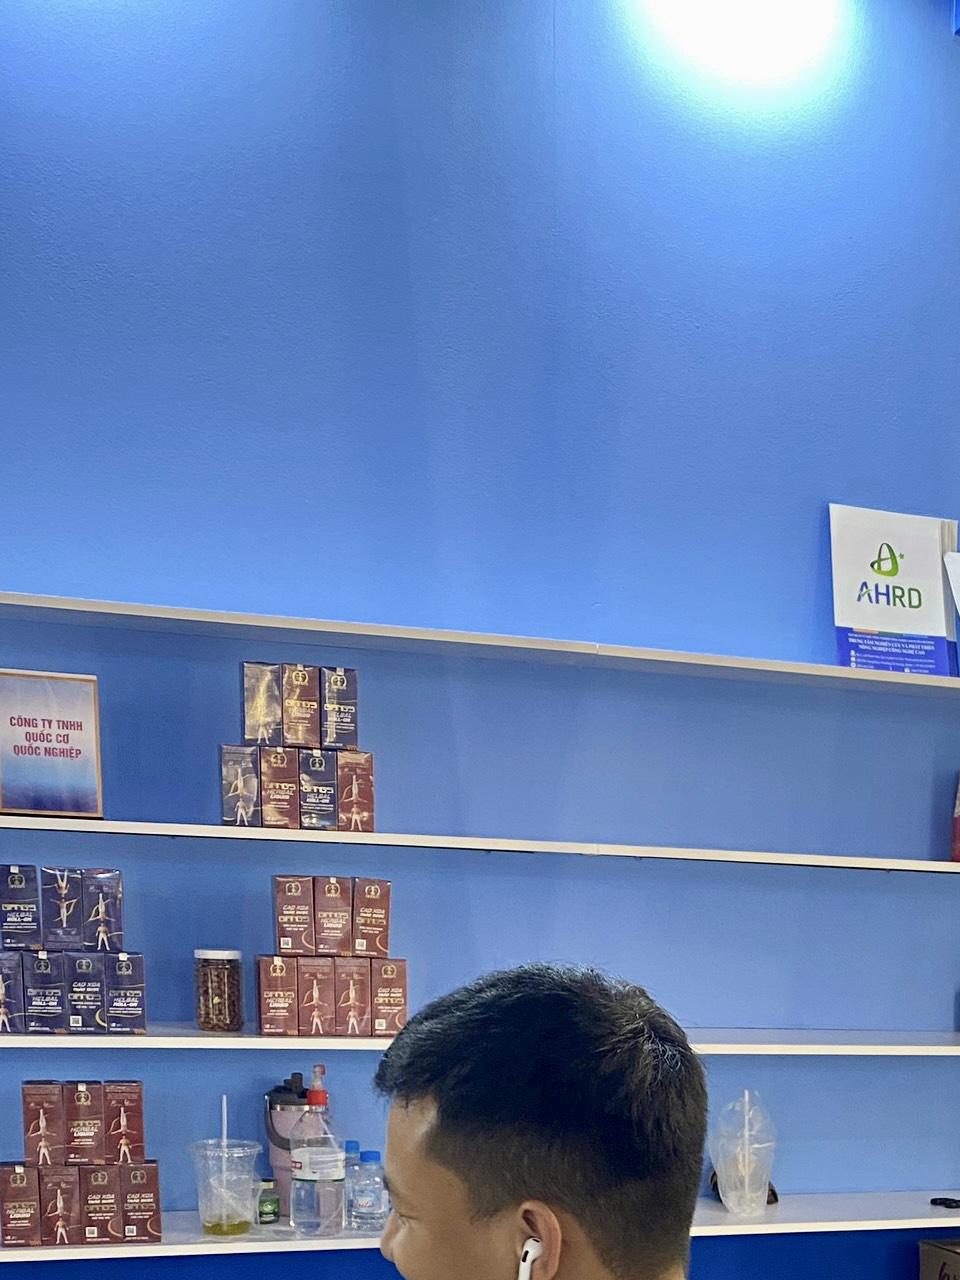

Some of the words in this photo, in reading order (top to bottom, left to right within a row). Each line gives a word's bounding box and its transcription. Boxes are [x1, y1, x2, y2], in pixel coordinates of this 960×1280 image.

[857, 581, 922, 609] AHRD
[10, 715, 38, 728] CÔNG
[40, 719, 53, 729] TY
[56, 720, 83, 731] TNHH
[25, 729, 52, 743] QUỐC
[56, 733, 70, 744] CƠ
[13, 743, 41, 756] QUỐC
[44, 746, 82, 760] NGHIỆP
